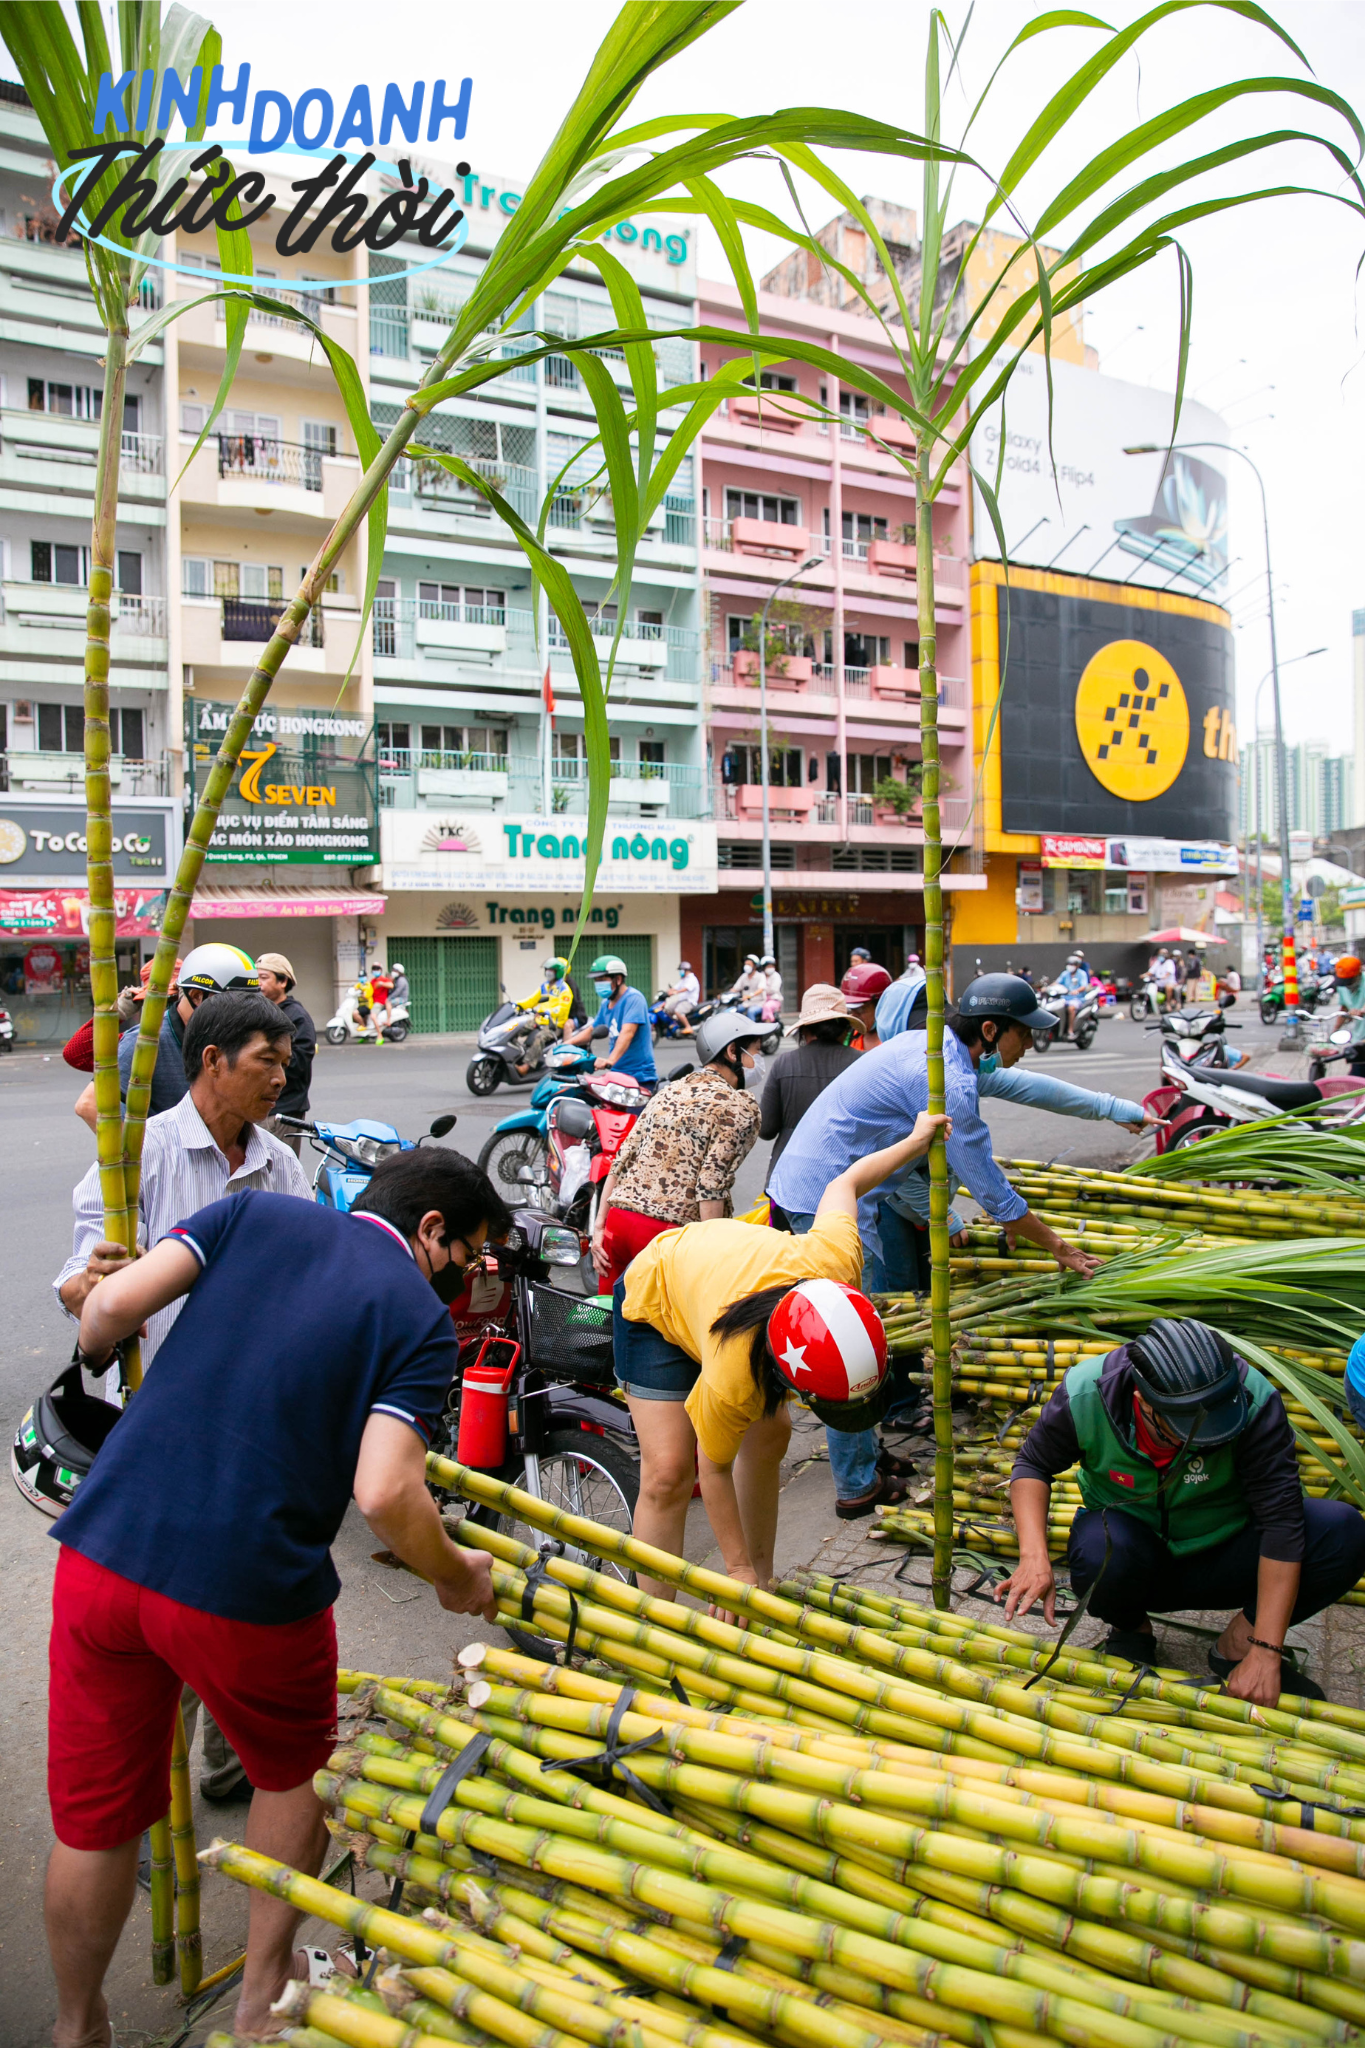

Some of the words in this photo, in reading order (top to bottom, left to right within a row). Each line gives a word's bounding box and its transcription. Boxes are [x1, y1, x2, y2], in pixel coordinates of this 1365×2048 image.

[279, 716, 367, 738] HONGKONG
[264, 784, 337, 806] SEVEN
[301, 813, 331, 829] TÂM
[332, 813, 369, 830] SÁNG
[29, 829, 152, 854] ToCooCo
[229, 831, 263, 847] MÓN
[264, 831, 294, 847] XÀO
[296, 833, 369, 847] HONGKONG
[612, 832, 689, 870] nông
[486, 902, 556, 929] Trang
[192, 975, 214, 986] FALCON
[1183, 1472, 1210, 1484] gojek
